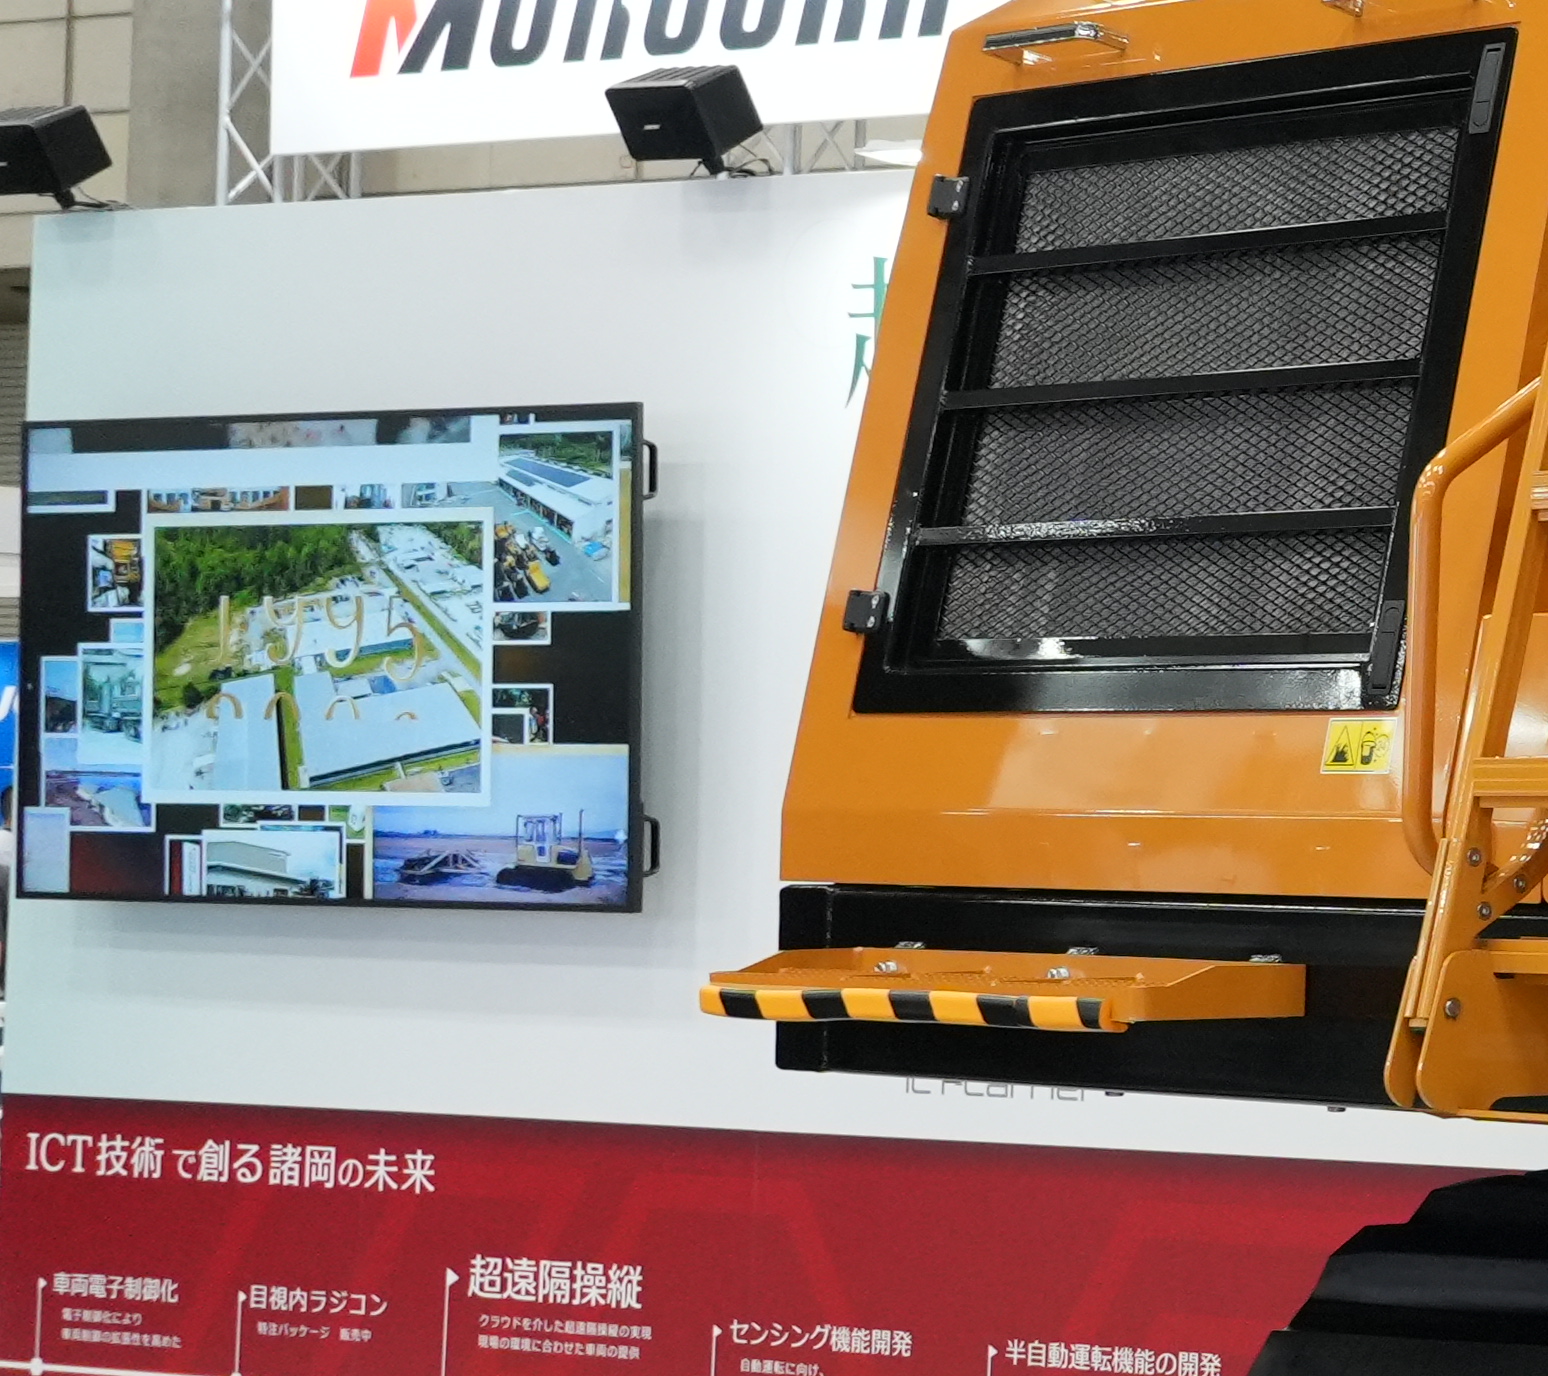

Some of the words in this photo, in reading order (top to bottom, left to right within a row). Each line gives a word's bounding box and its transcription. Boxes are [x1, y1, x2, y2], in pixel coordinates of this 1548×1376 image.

[26, 1132, 437, 1194] ICT技術で創る諸岡の未来
[53, 1272, 179, 1303] 車両電子制御化
[249, 1284, 388, 1317] 目視内ラジコン
[468, 1254, 643, 1310] 超遠隔操縦
[729, 1318, 914, 1358] センシング機能開発
